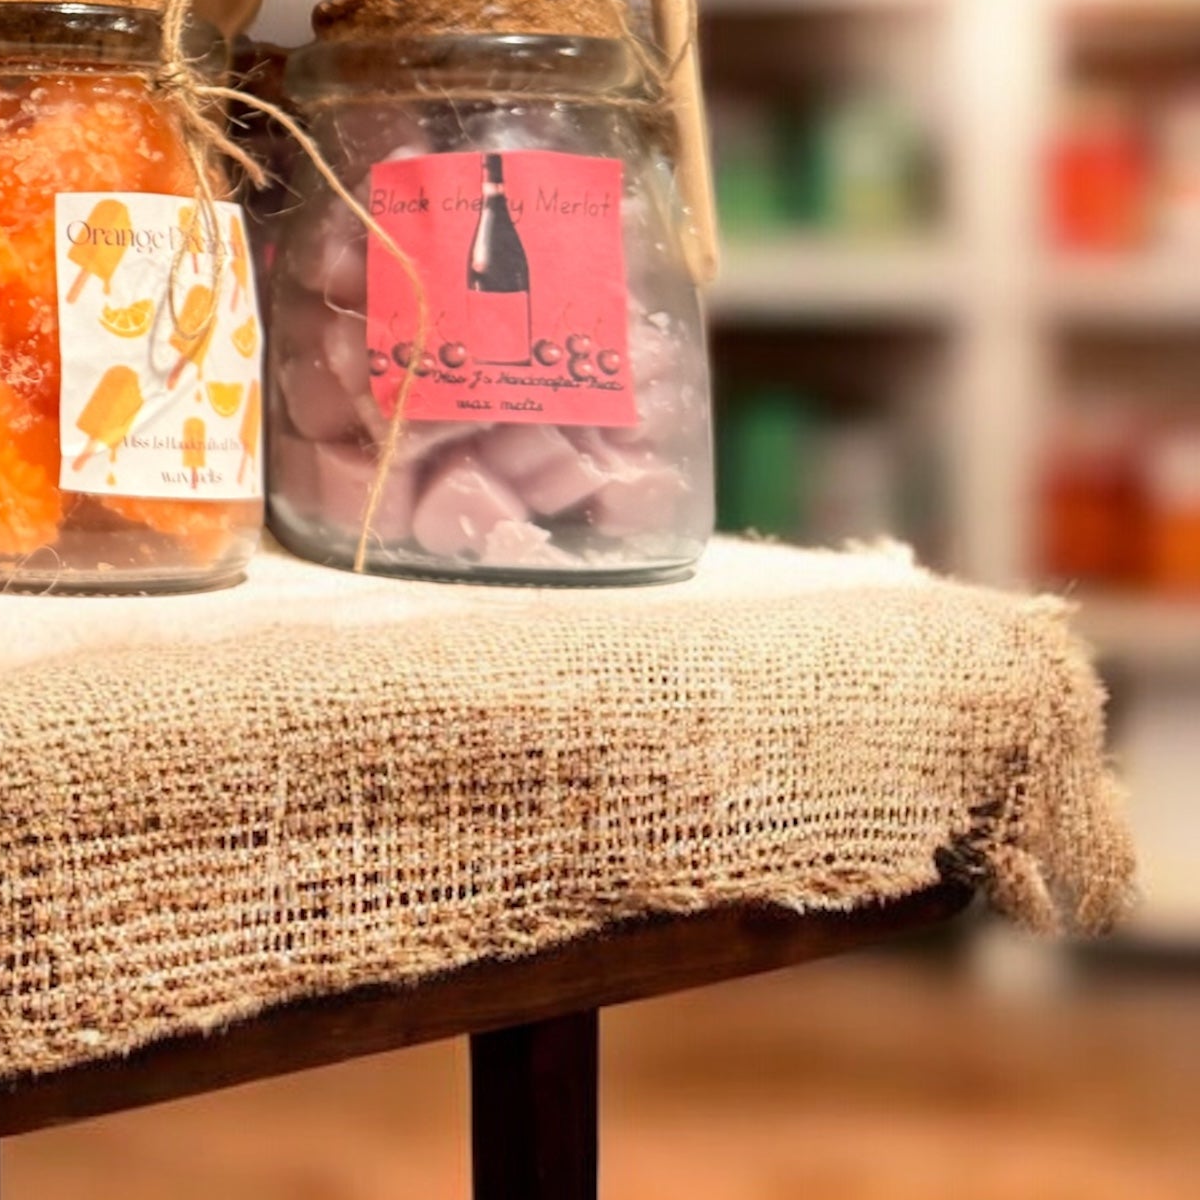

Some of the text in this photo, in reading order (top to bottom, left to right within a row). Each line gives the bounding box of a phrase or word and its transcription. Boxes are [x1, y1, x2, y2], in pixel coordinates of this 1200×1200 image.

[371, 185, 612, 224] Black chey Merlot
[66, 219, 165, 254] Orange
